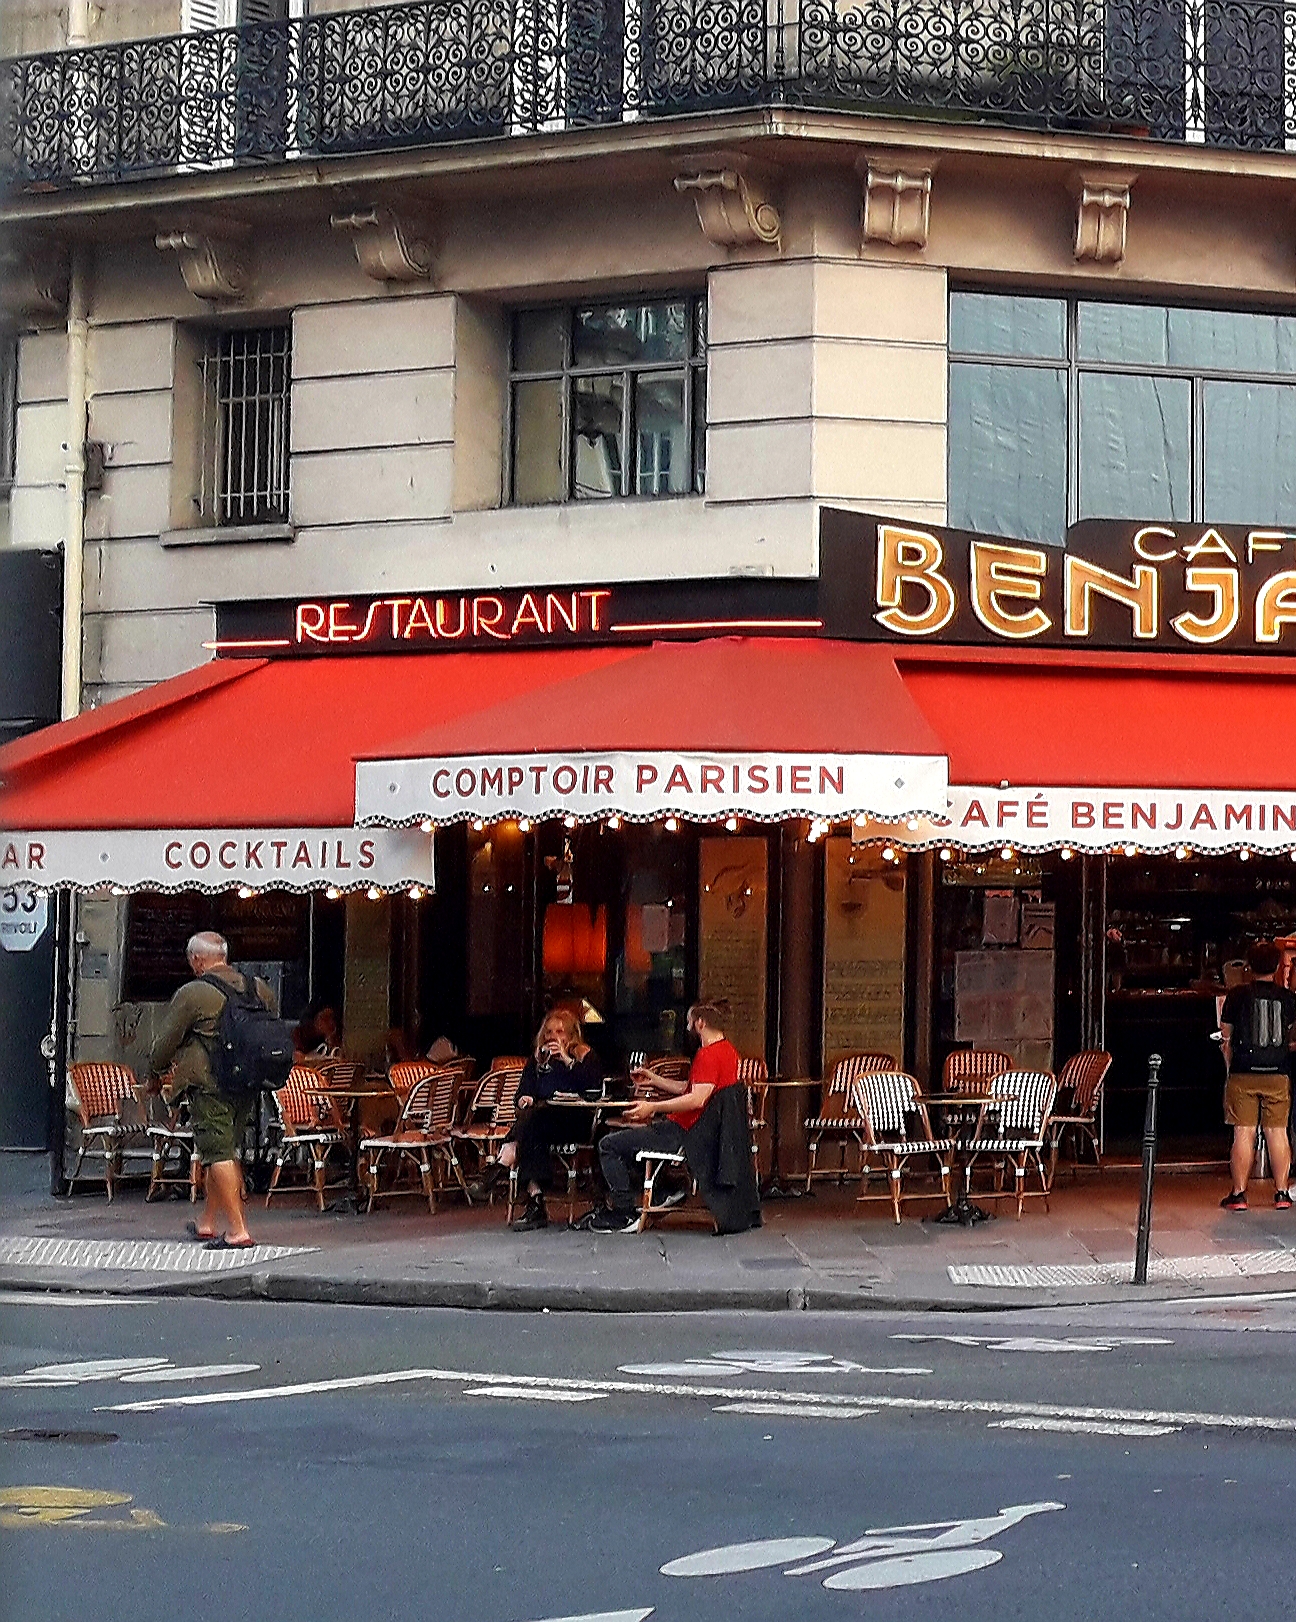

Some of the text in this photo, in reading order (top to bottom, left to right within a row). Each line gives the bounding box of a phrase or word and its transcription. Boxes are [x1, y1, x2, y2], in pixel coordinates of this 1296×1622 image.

[294, 590, 611, 643] RESTAURANT
[432, 764, 844, 799] COMPTOIR PARISIEN
[1071, 801, 1296, 831] BENJAMIN
[165, 840, 375, 870] COCKTAILS
